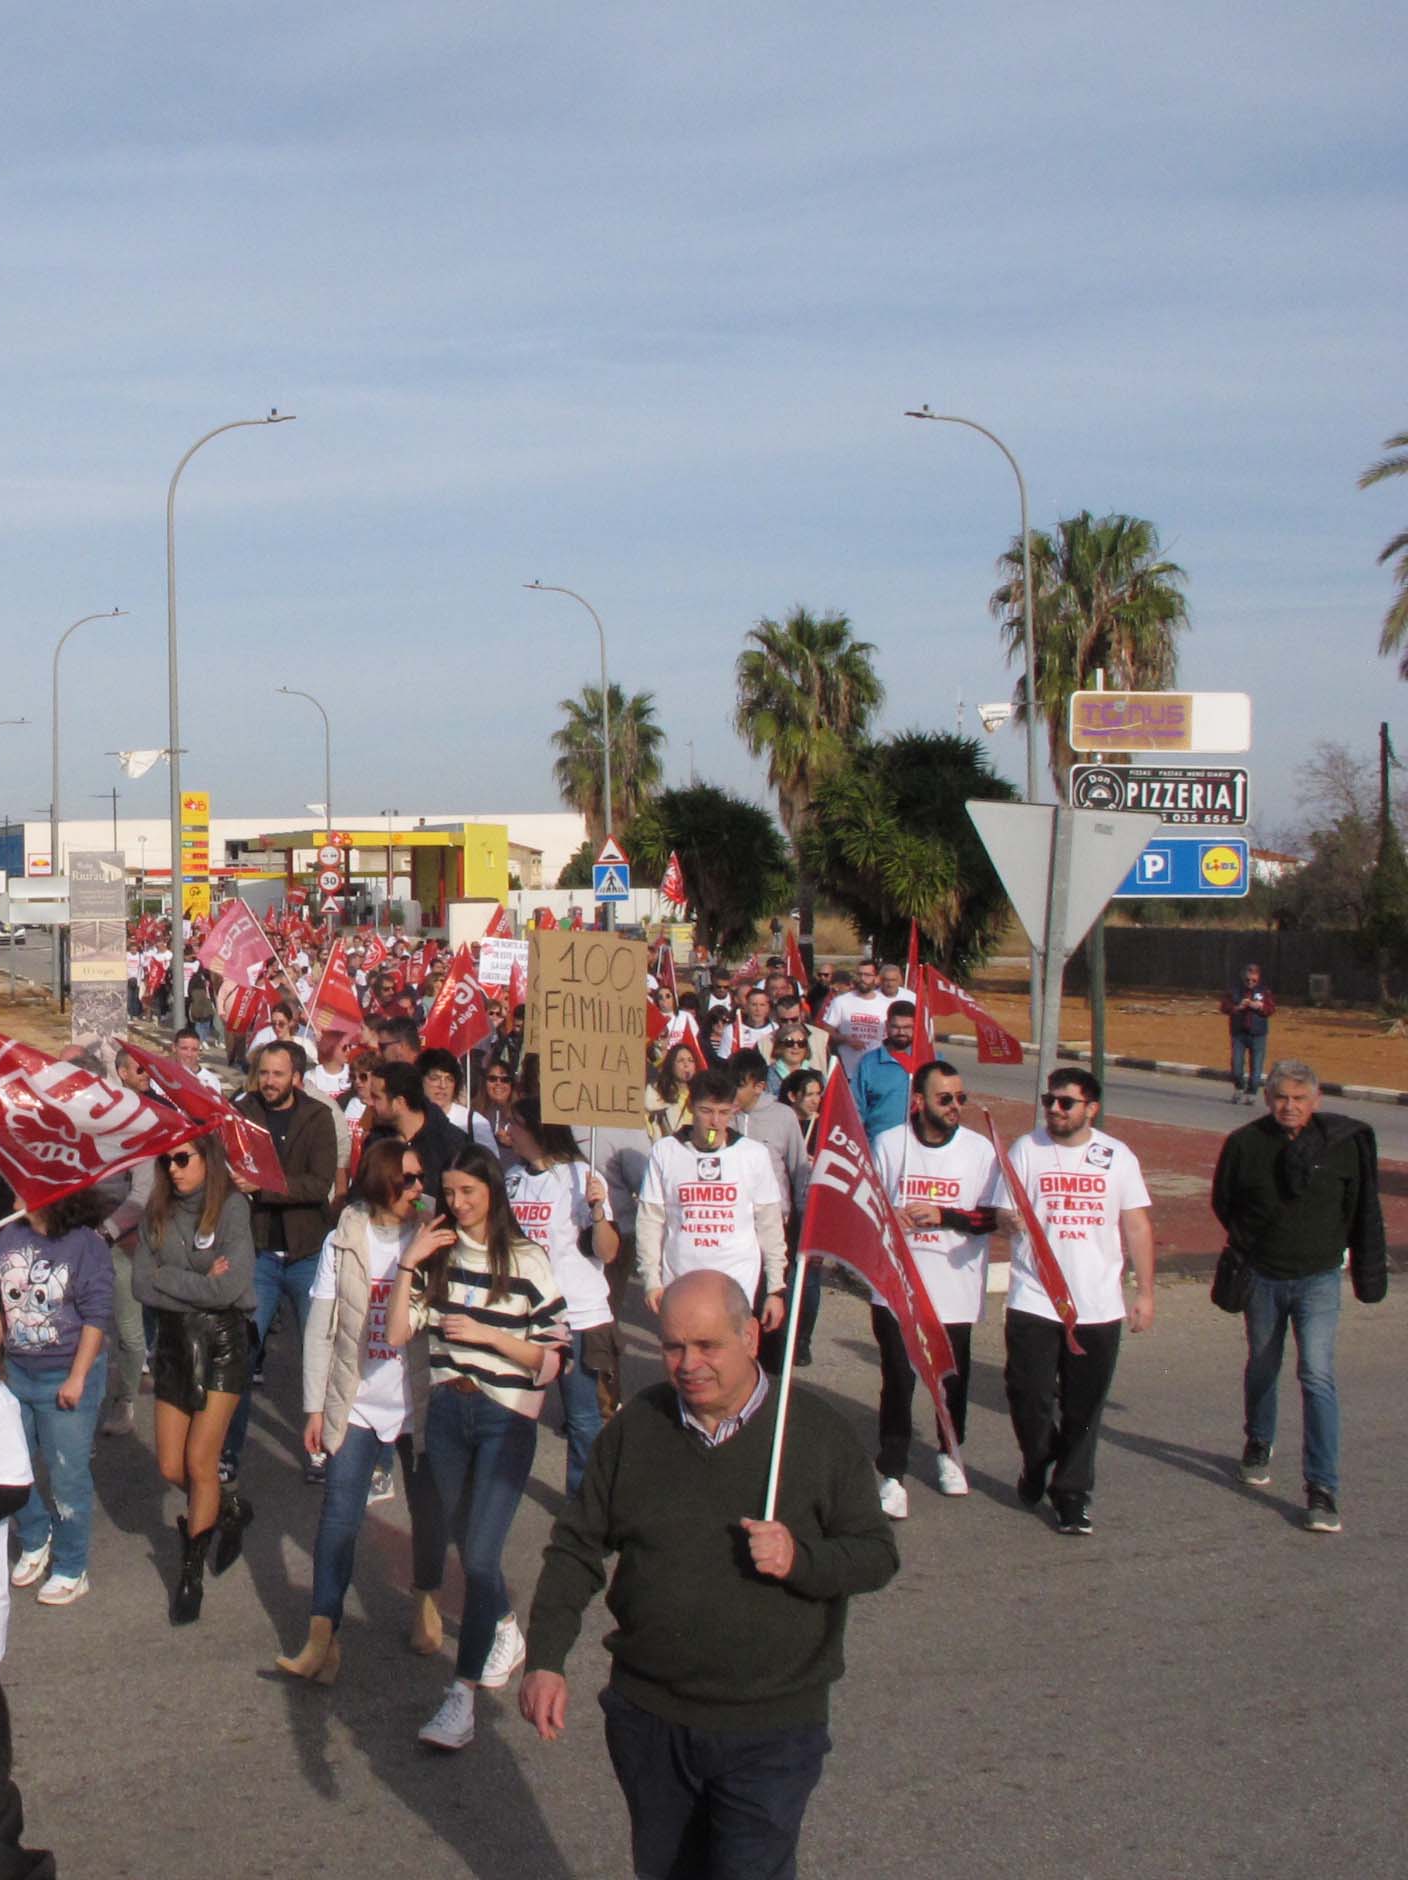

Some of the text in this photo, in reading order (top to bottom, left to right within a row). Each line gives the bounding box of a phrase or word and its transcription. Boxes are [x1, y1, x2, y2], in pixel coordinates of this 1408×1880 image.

[1088, 774, 1110, 784] Don
[1127, 783, 1232, 809] PIZZERIA
[1143, 854, 1164, 879] P
[323, 876, 337, 885] 30
[559, 942, 636, 991] 100
[549, 1040, 633, 1075] EN LA
[552, 1081, 640, 1113] CALLE
[1040, 1177, 1106, 1193] BIMBO
[678, 1187, 737, 1203] BIMBO
[514, 1205, 552, 1221] MBO
[1047, 1201, 1061, 1210] SE
[698, 1210, 734, 1219] LLEVA
[1046, 1216, 1105, 1225] NUESTRO
[528, 1230, 548, 1240] EVA
[680, 1224, 735, 1233] NUESTRO
